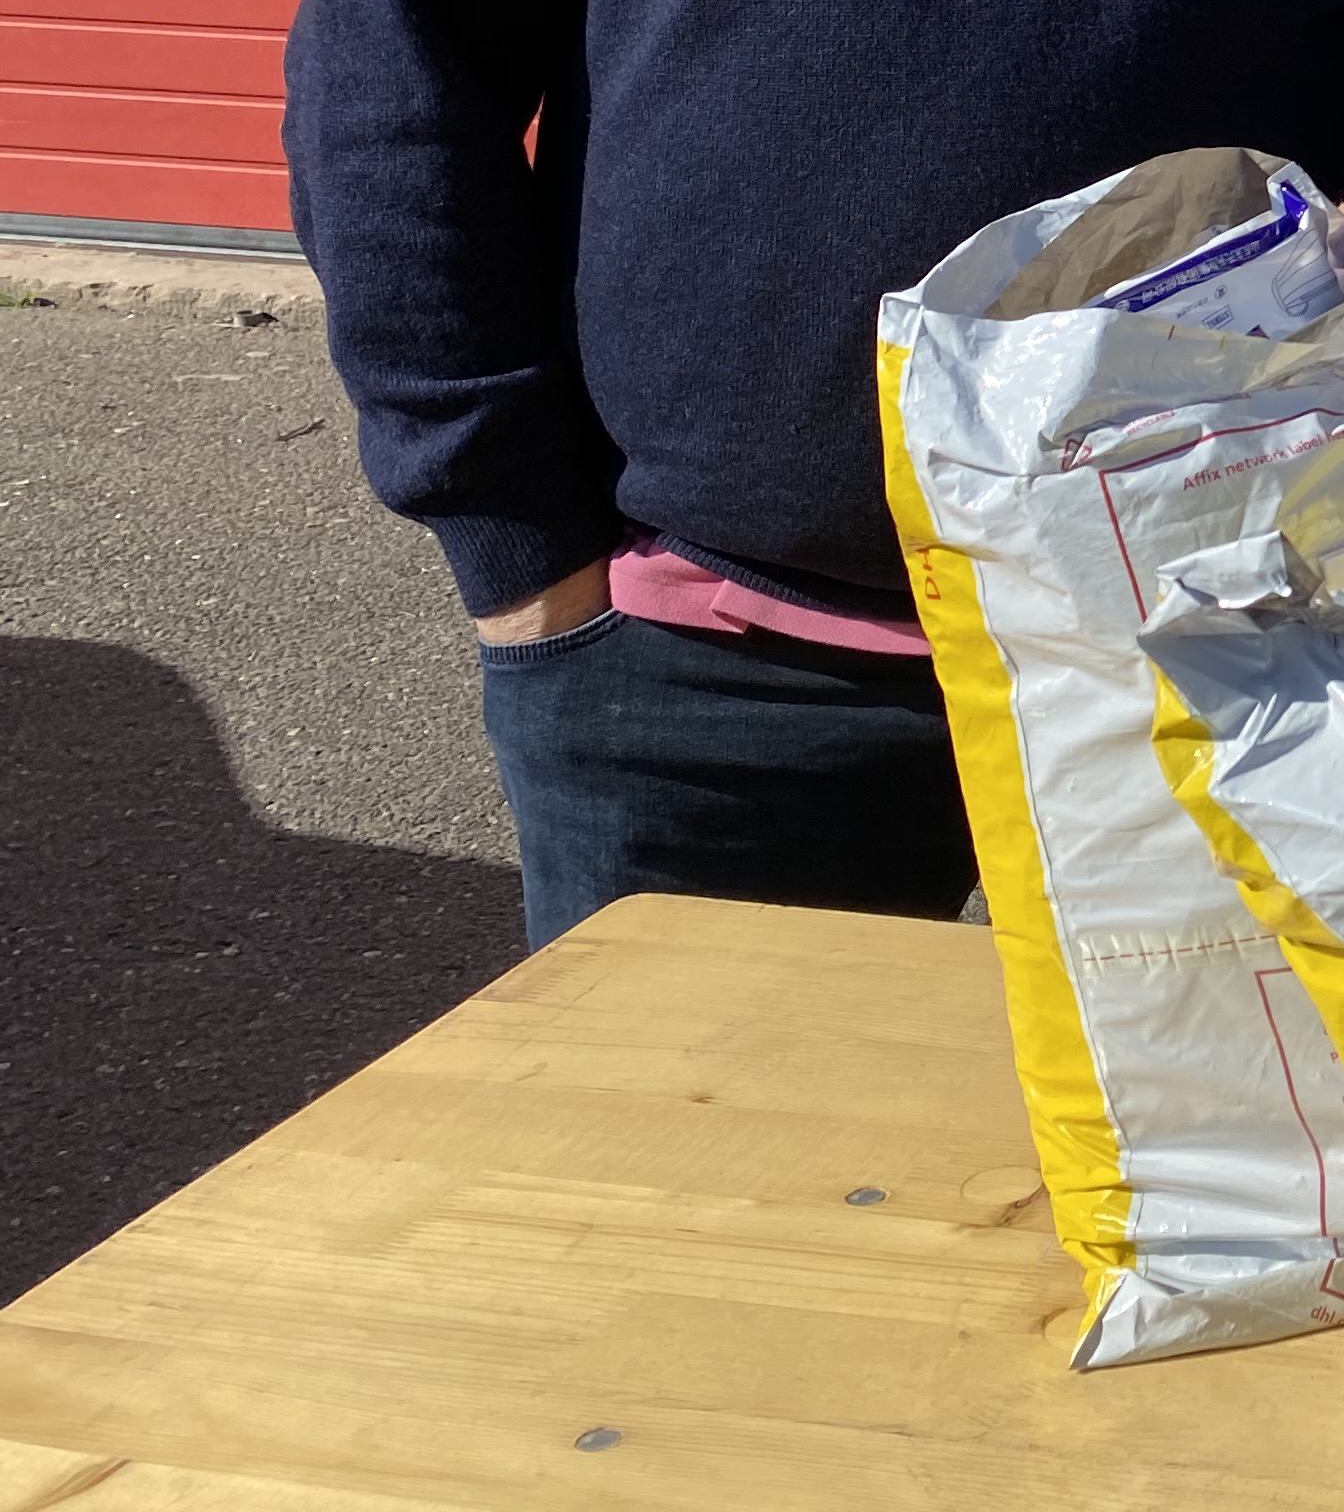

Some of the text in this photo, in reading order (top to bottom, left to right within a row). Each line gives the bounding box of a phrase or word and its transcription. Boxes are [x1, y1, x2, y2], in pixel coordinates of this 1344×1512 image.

[1180, 467, 1221, 491] Affix
[1223, 447, 1286, 476] network
[1286, 434, 1323, 455] label
[916, 549, 940, 598] DH
